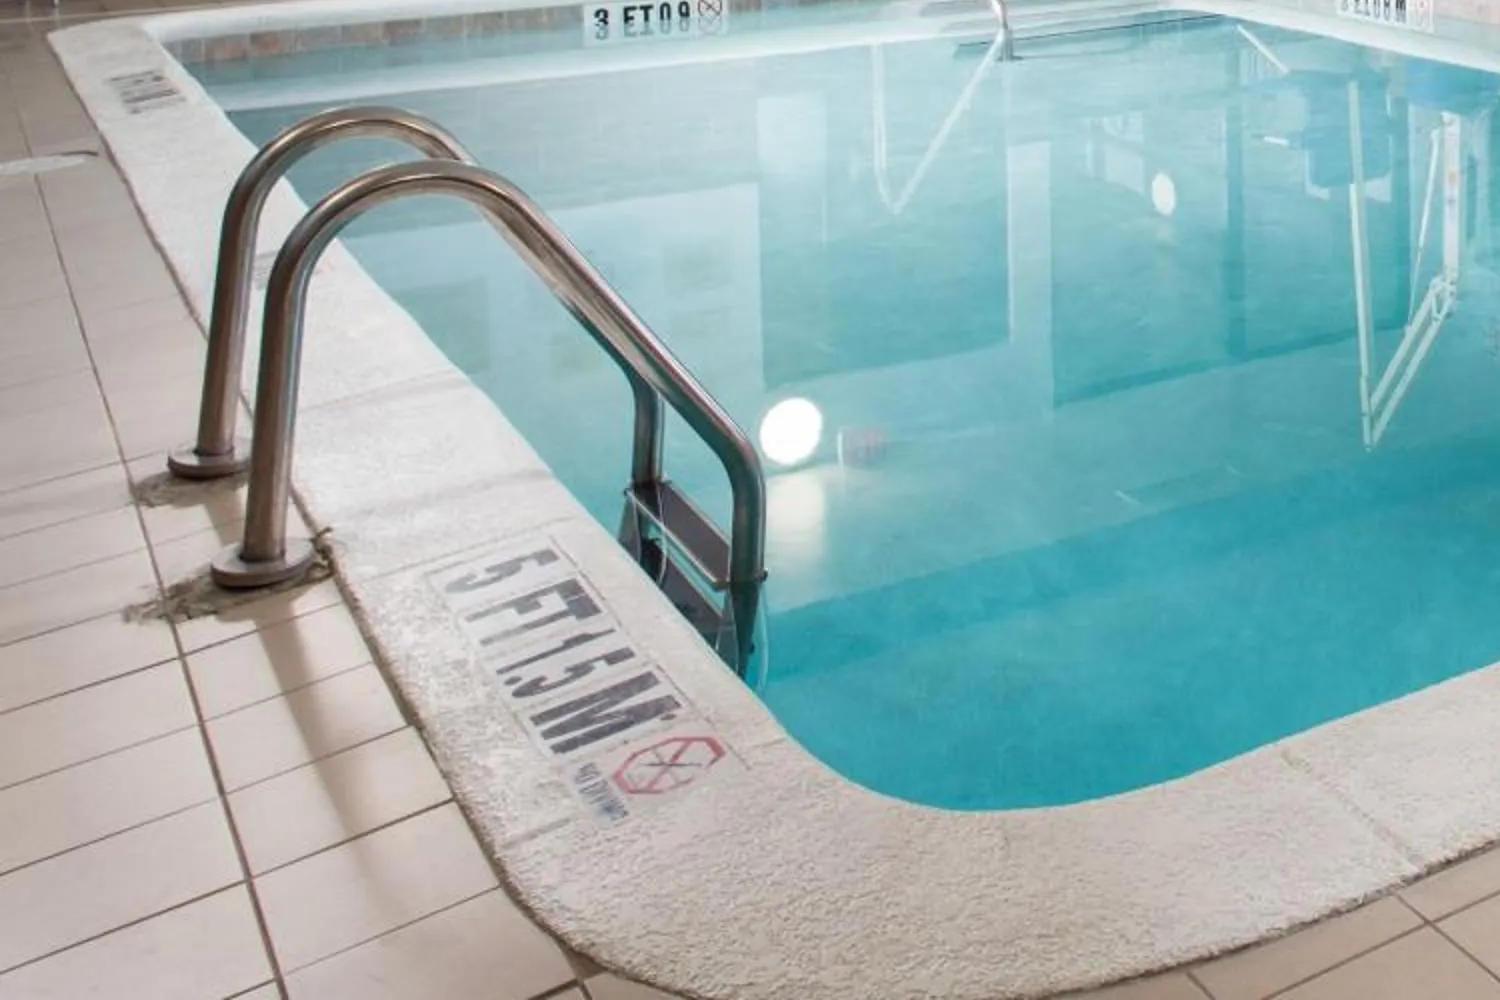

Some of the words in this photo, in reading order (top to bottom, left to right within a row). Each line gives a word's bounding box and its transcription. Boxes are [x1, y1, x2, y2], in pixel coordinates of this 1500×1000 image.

[444, 548, 560, 593] 5
[464, 577, 603, 646] FT
[495, 627, 636, 698] 1.5
[530, 671, 682, 754] M
